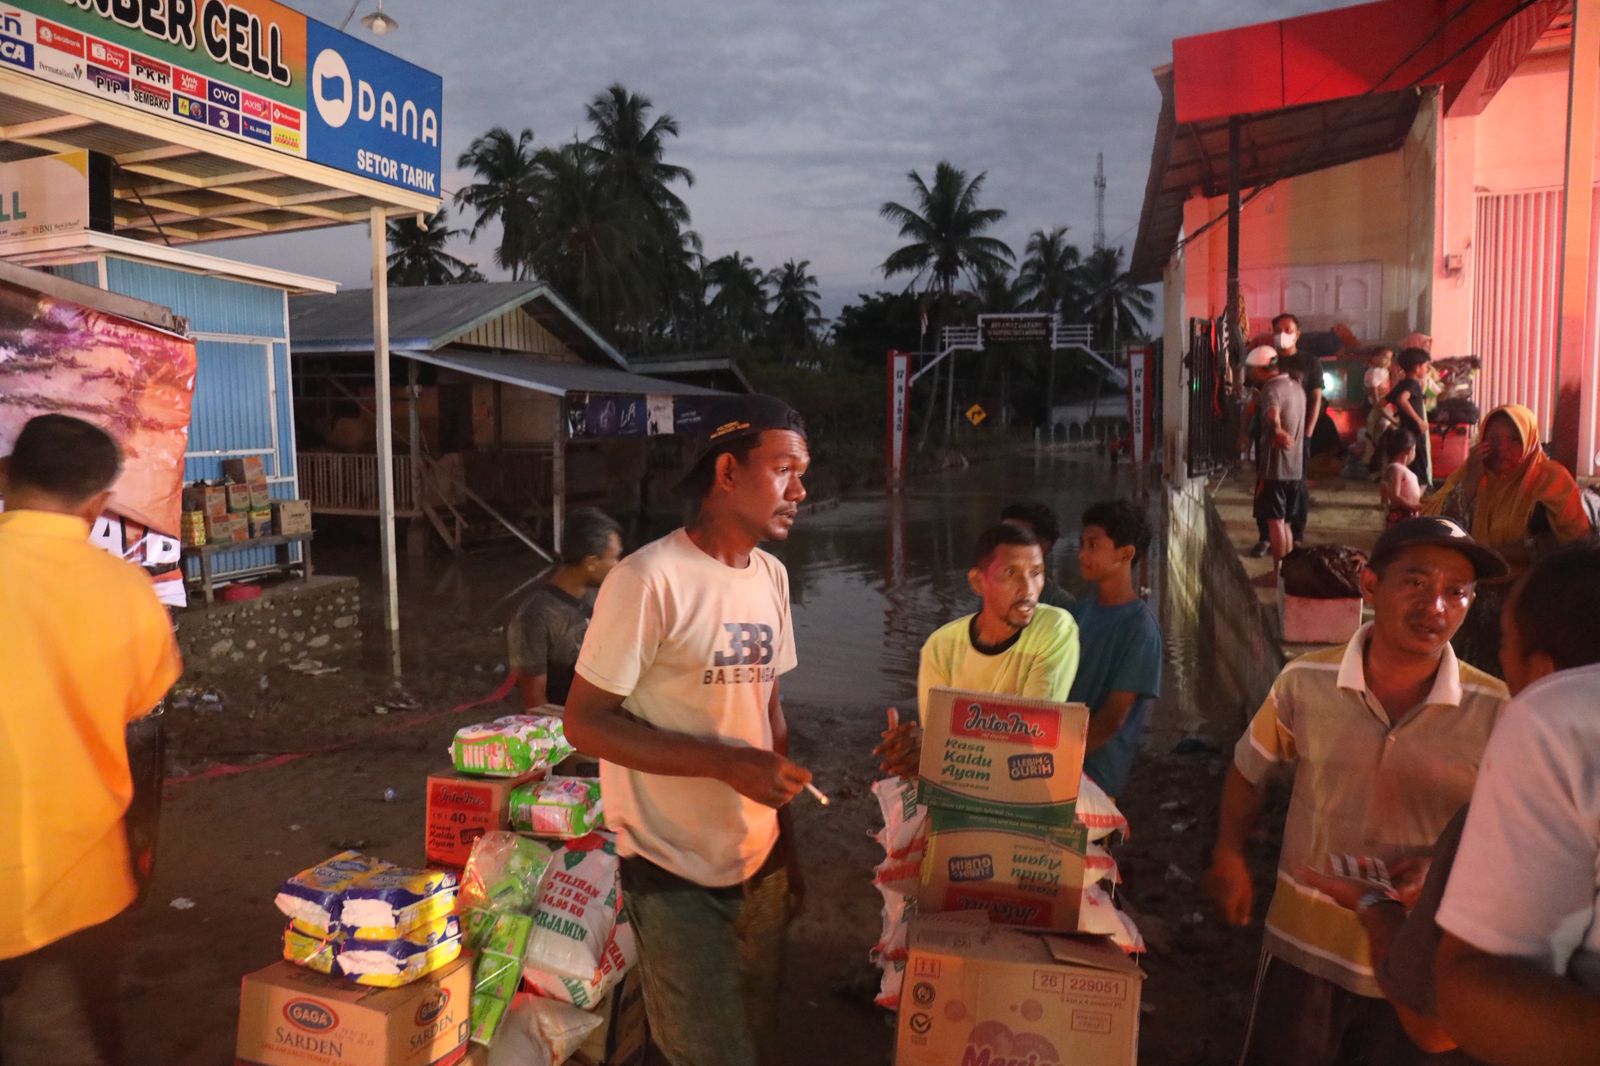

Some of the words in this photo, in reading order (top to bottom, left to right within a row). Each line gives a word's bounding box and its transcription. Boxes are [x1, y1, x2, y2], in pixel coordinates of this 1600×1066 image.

[0, 41, 26, 63] CA
[202, 0, 291, 86] CELL
[106, 53, 124, 69] Pay
[136, 65, 167, 85] PKH
[96, 76, 121, 94] PIP
[134, 89, 170, 111] SEMBAKO
[213, 88, 237, 105] OVO
[244, 99, 262, 112] AXIS
[219, 111, 230, 129] 3
[358, 79, 438, 148] DANA
[357, 148, 398, 181] SETOR
[401, 163, 436, 192] TARIK
[945, 738, 986, 753] Rasa
[943, 749, 992, 767] Kaldu
[942, 763, 991, 781] Ayam
[1010, 764, 1052, 779] GURIH
[450, 812, 466, 824] 40
[552, 870, 601, 898] PILIHAN
[1040, 974, 1057, 988] 26
[292, 1005, 329, 1027] GAGA
[409, 1009, 454, 1049] SARDEN
[275, 1025, 344, 1058] SARDEN
